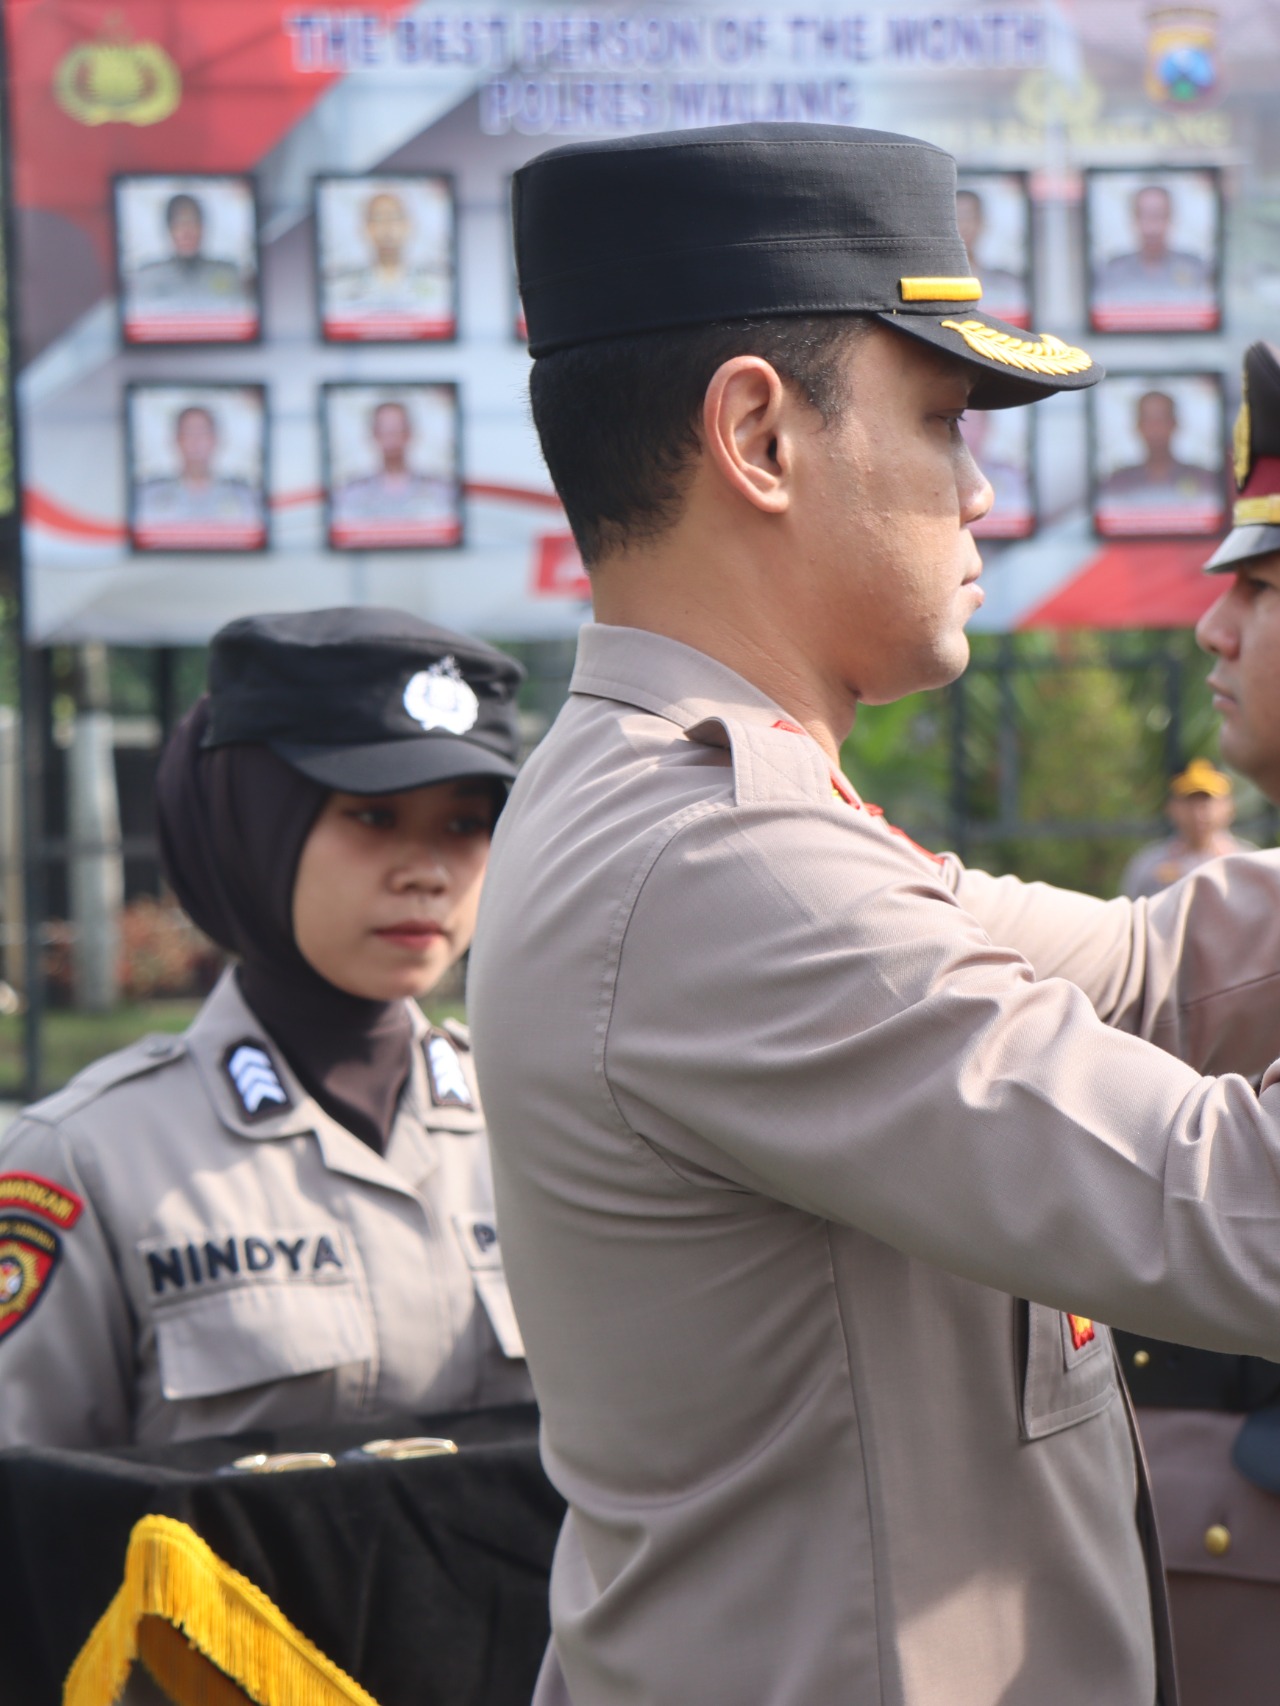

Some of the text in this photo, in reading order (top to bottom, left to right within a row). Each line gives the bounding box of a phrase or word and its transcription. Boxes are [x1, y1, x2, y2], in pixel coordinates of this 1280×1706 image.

[289, 14, 1046, 68] THE BEST PERSON OF THE MONTH
[484, 79, 858, 128] POLRES MALANG
[146, 1236, 342, 1294] NINDYA
